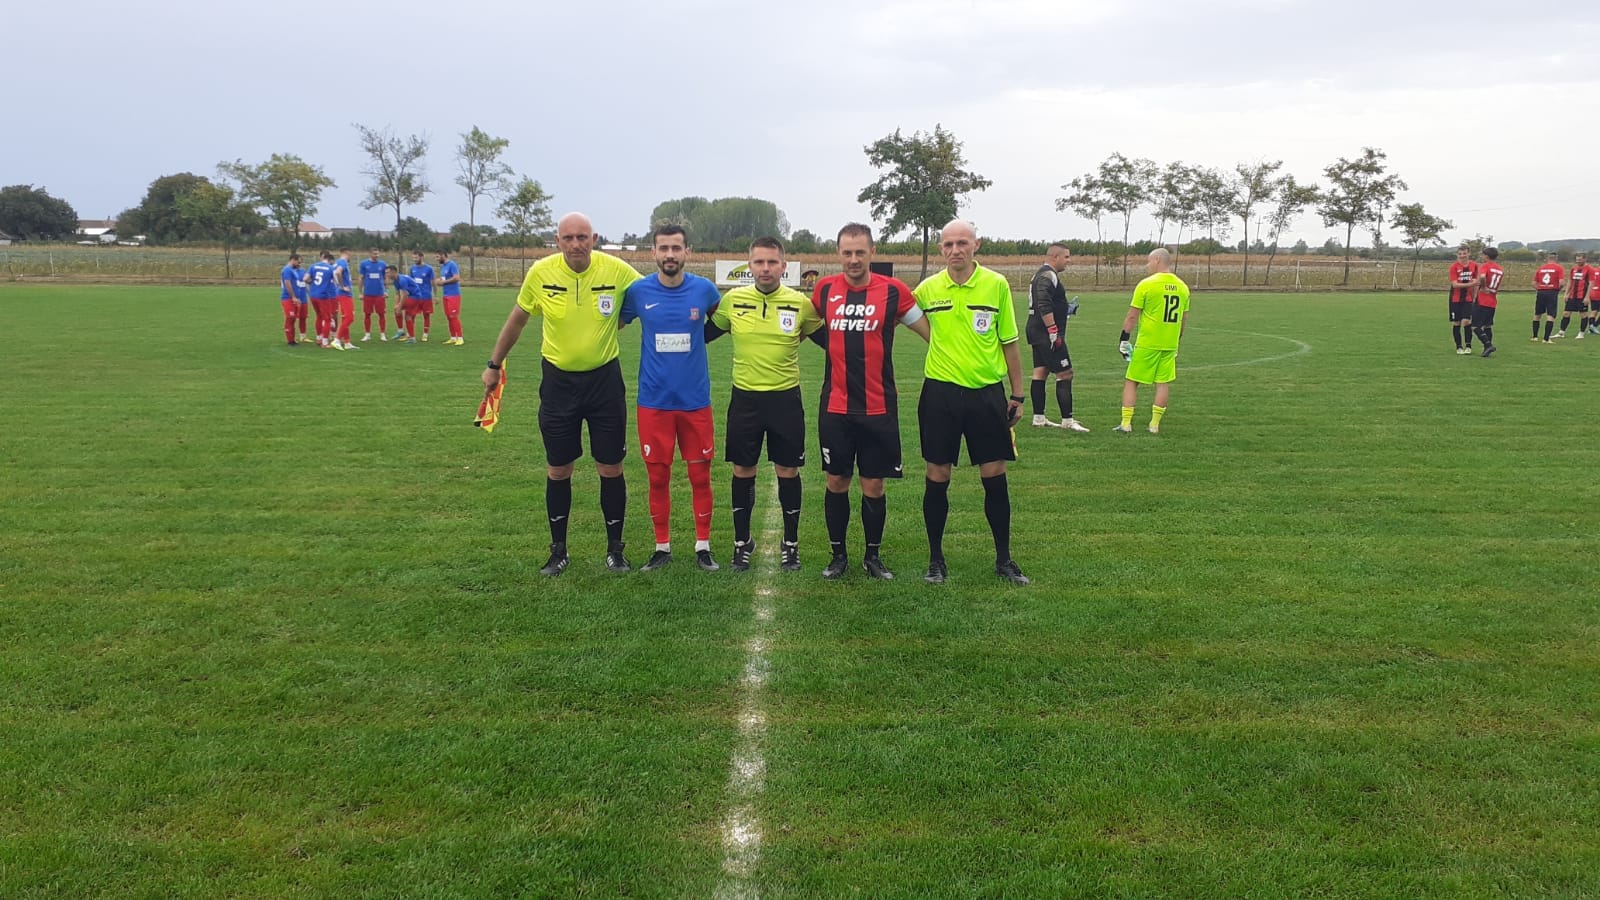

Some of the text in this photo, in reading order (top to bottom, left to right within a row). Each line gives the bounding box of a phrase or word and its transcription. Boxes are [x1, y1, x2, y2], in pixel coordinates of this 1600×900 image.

[314, 271, 324, 286] 5
[1489, 273, 1502, 289] 11
[1542, 272, 1551, 284] 4
[835, 303, 876, 317] AGRO
[1163, 294, 1180, 322] 12
[830, 318, 879, 332] HEVELI
[643, 444, 651, 457] 9
[822, 447, 831, 464] 5
